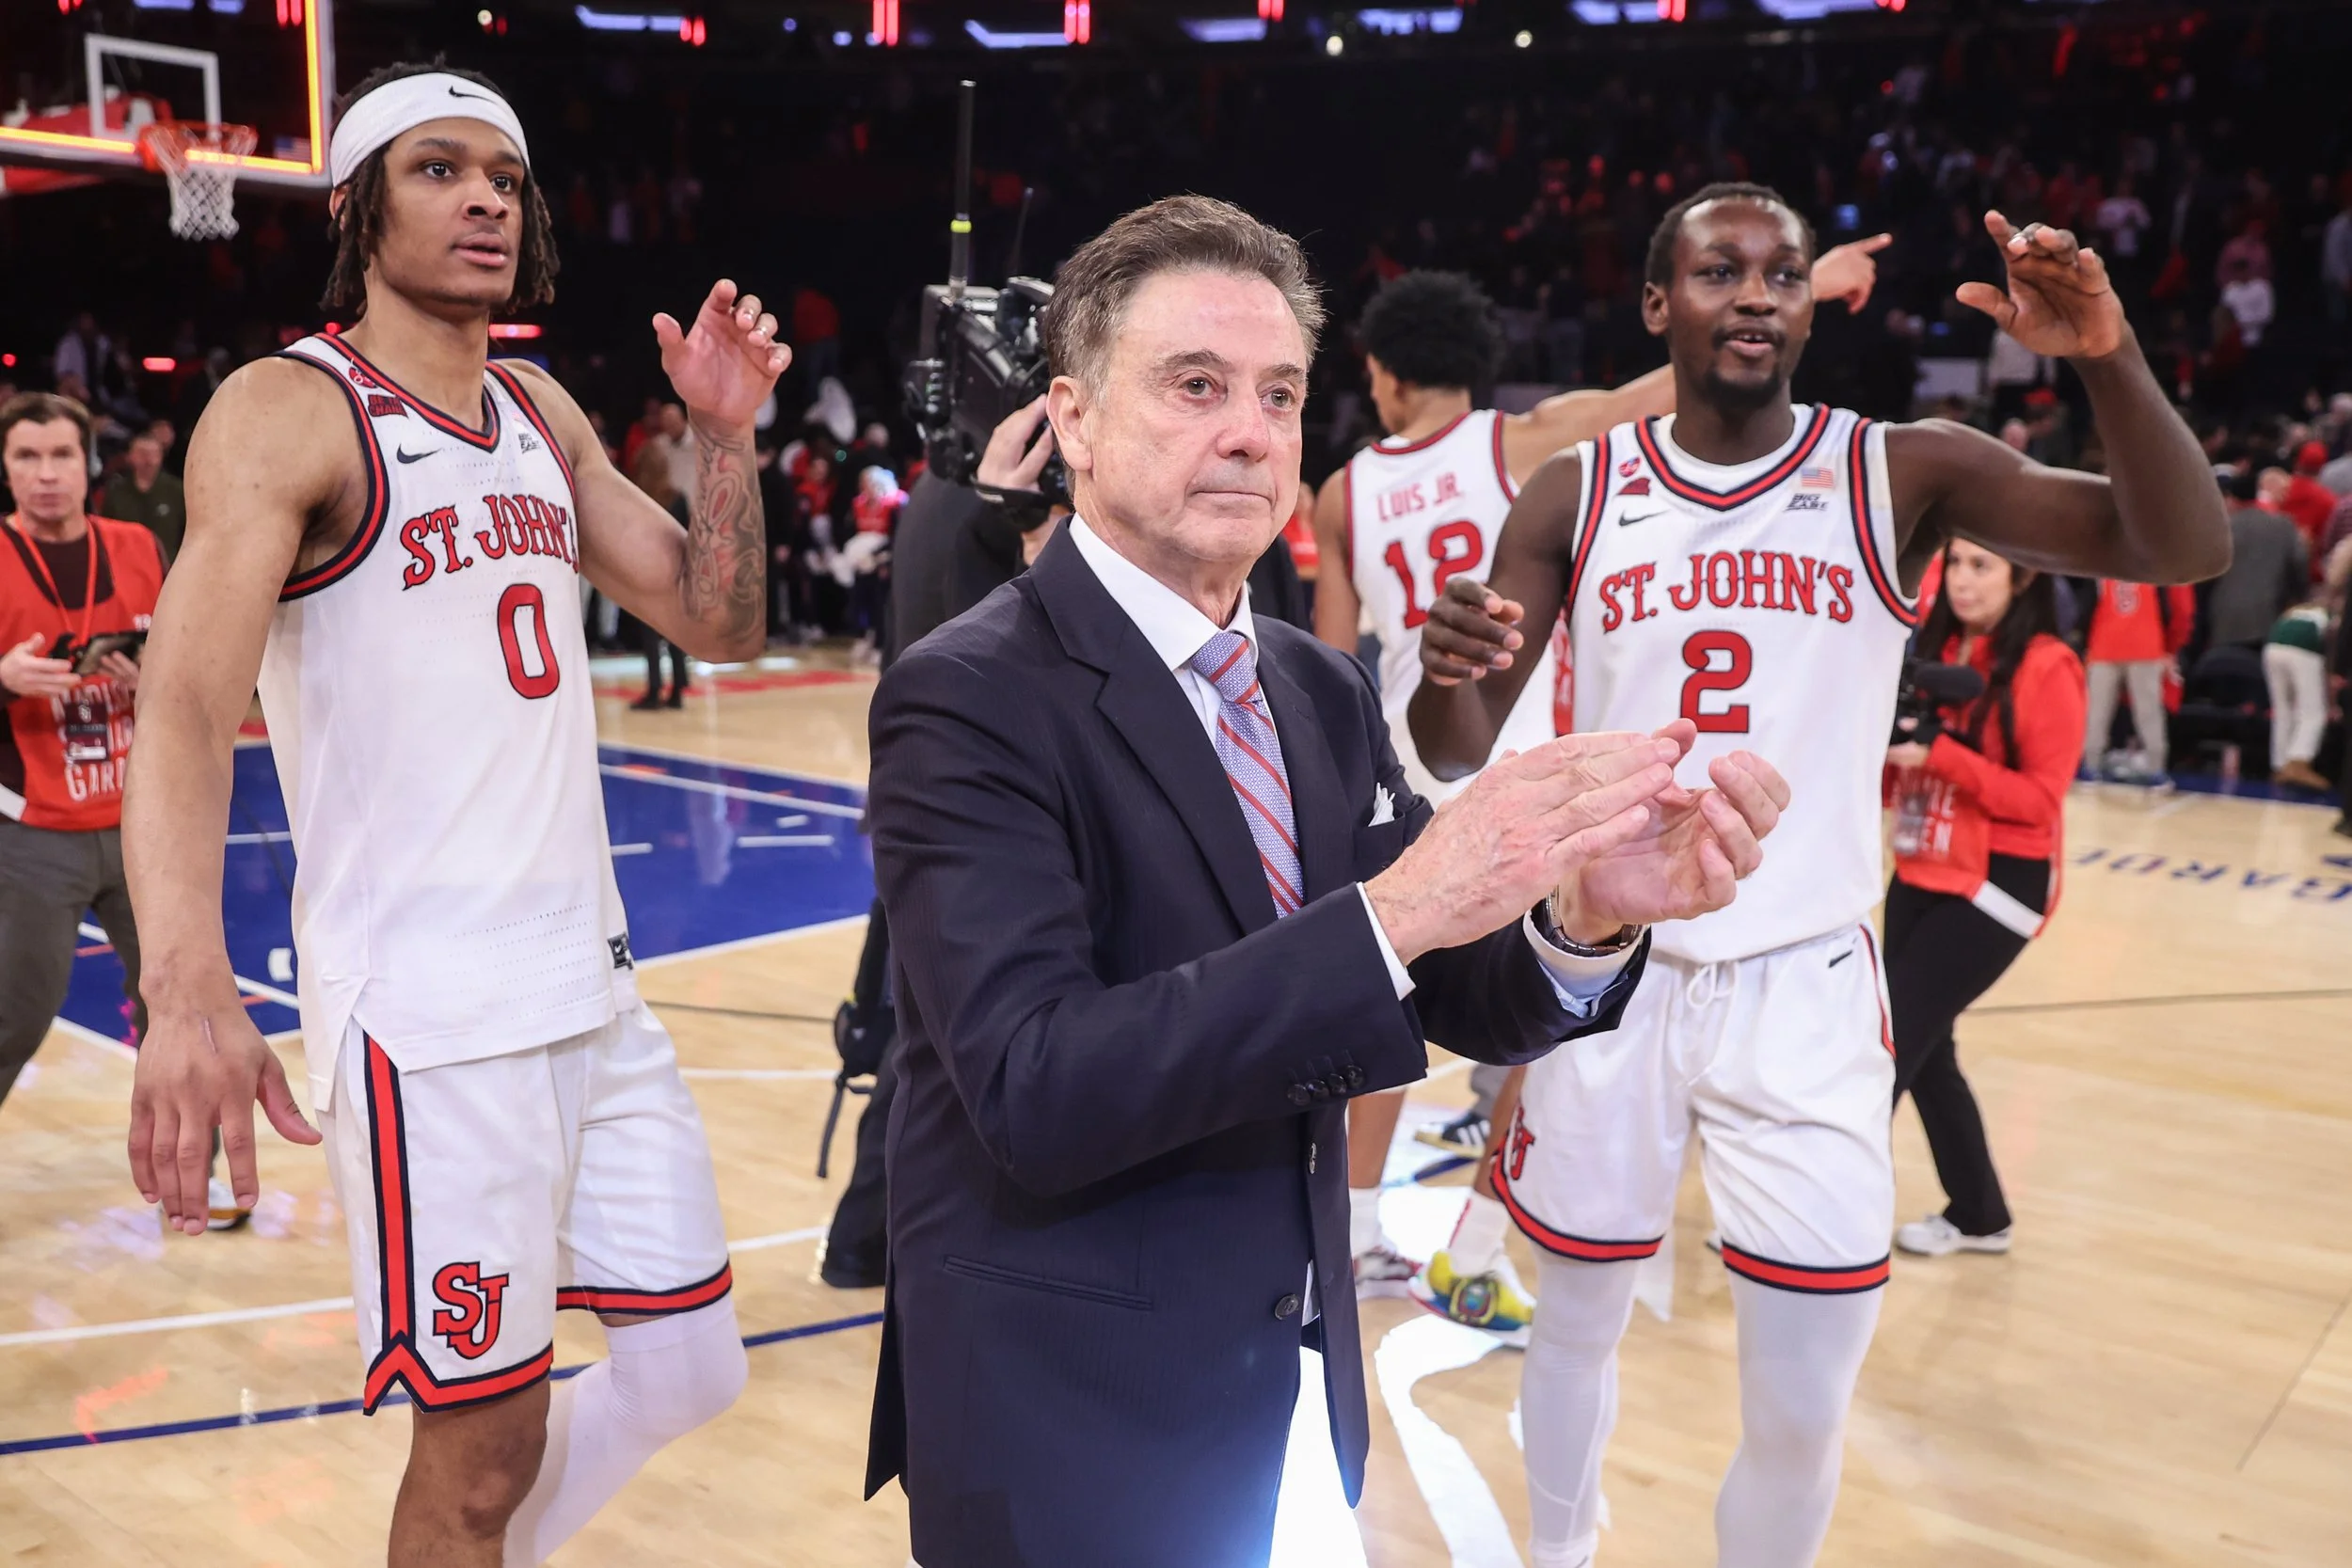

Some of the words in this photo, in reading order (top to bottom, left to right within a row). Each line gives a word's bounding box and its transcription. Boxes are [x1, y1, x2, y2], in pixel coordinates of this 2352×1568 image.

[400, 504, 473, 591] ST.
[474, 494, 580, 574] JOHN'
[1377, 483, 1425, 522] LUIS
[1787, 499, 1829, 509] EAST
[1792, 493, 1821, 501] BIG
[1385, 520, 1483, 629] 12
[1599, 561, 1658, 635] ST.
[1668, 549, 1853, 624] JOHN'S
[497, 583, 560, 699] 0
[1680, 629, 1753, 734] 2
[432, 1260, 509, 1360] SJ
